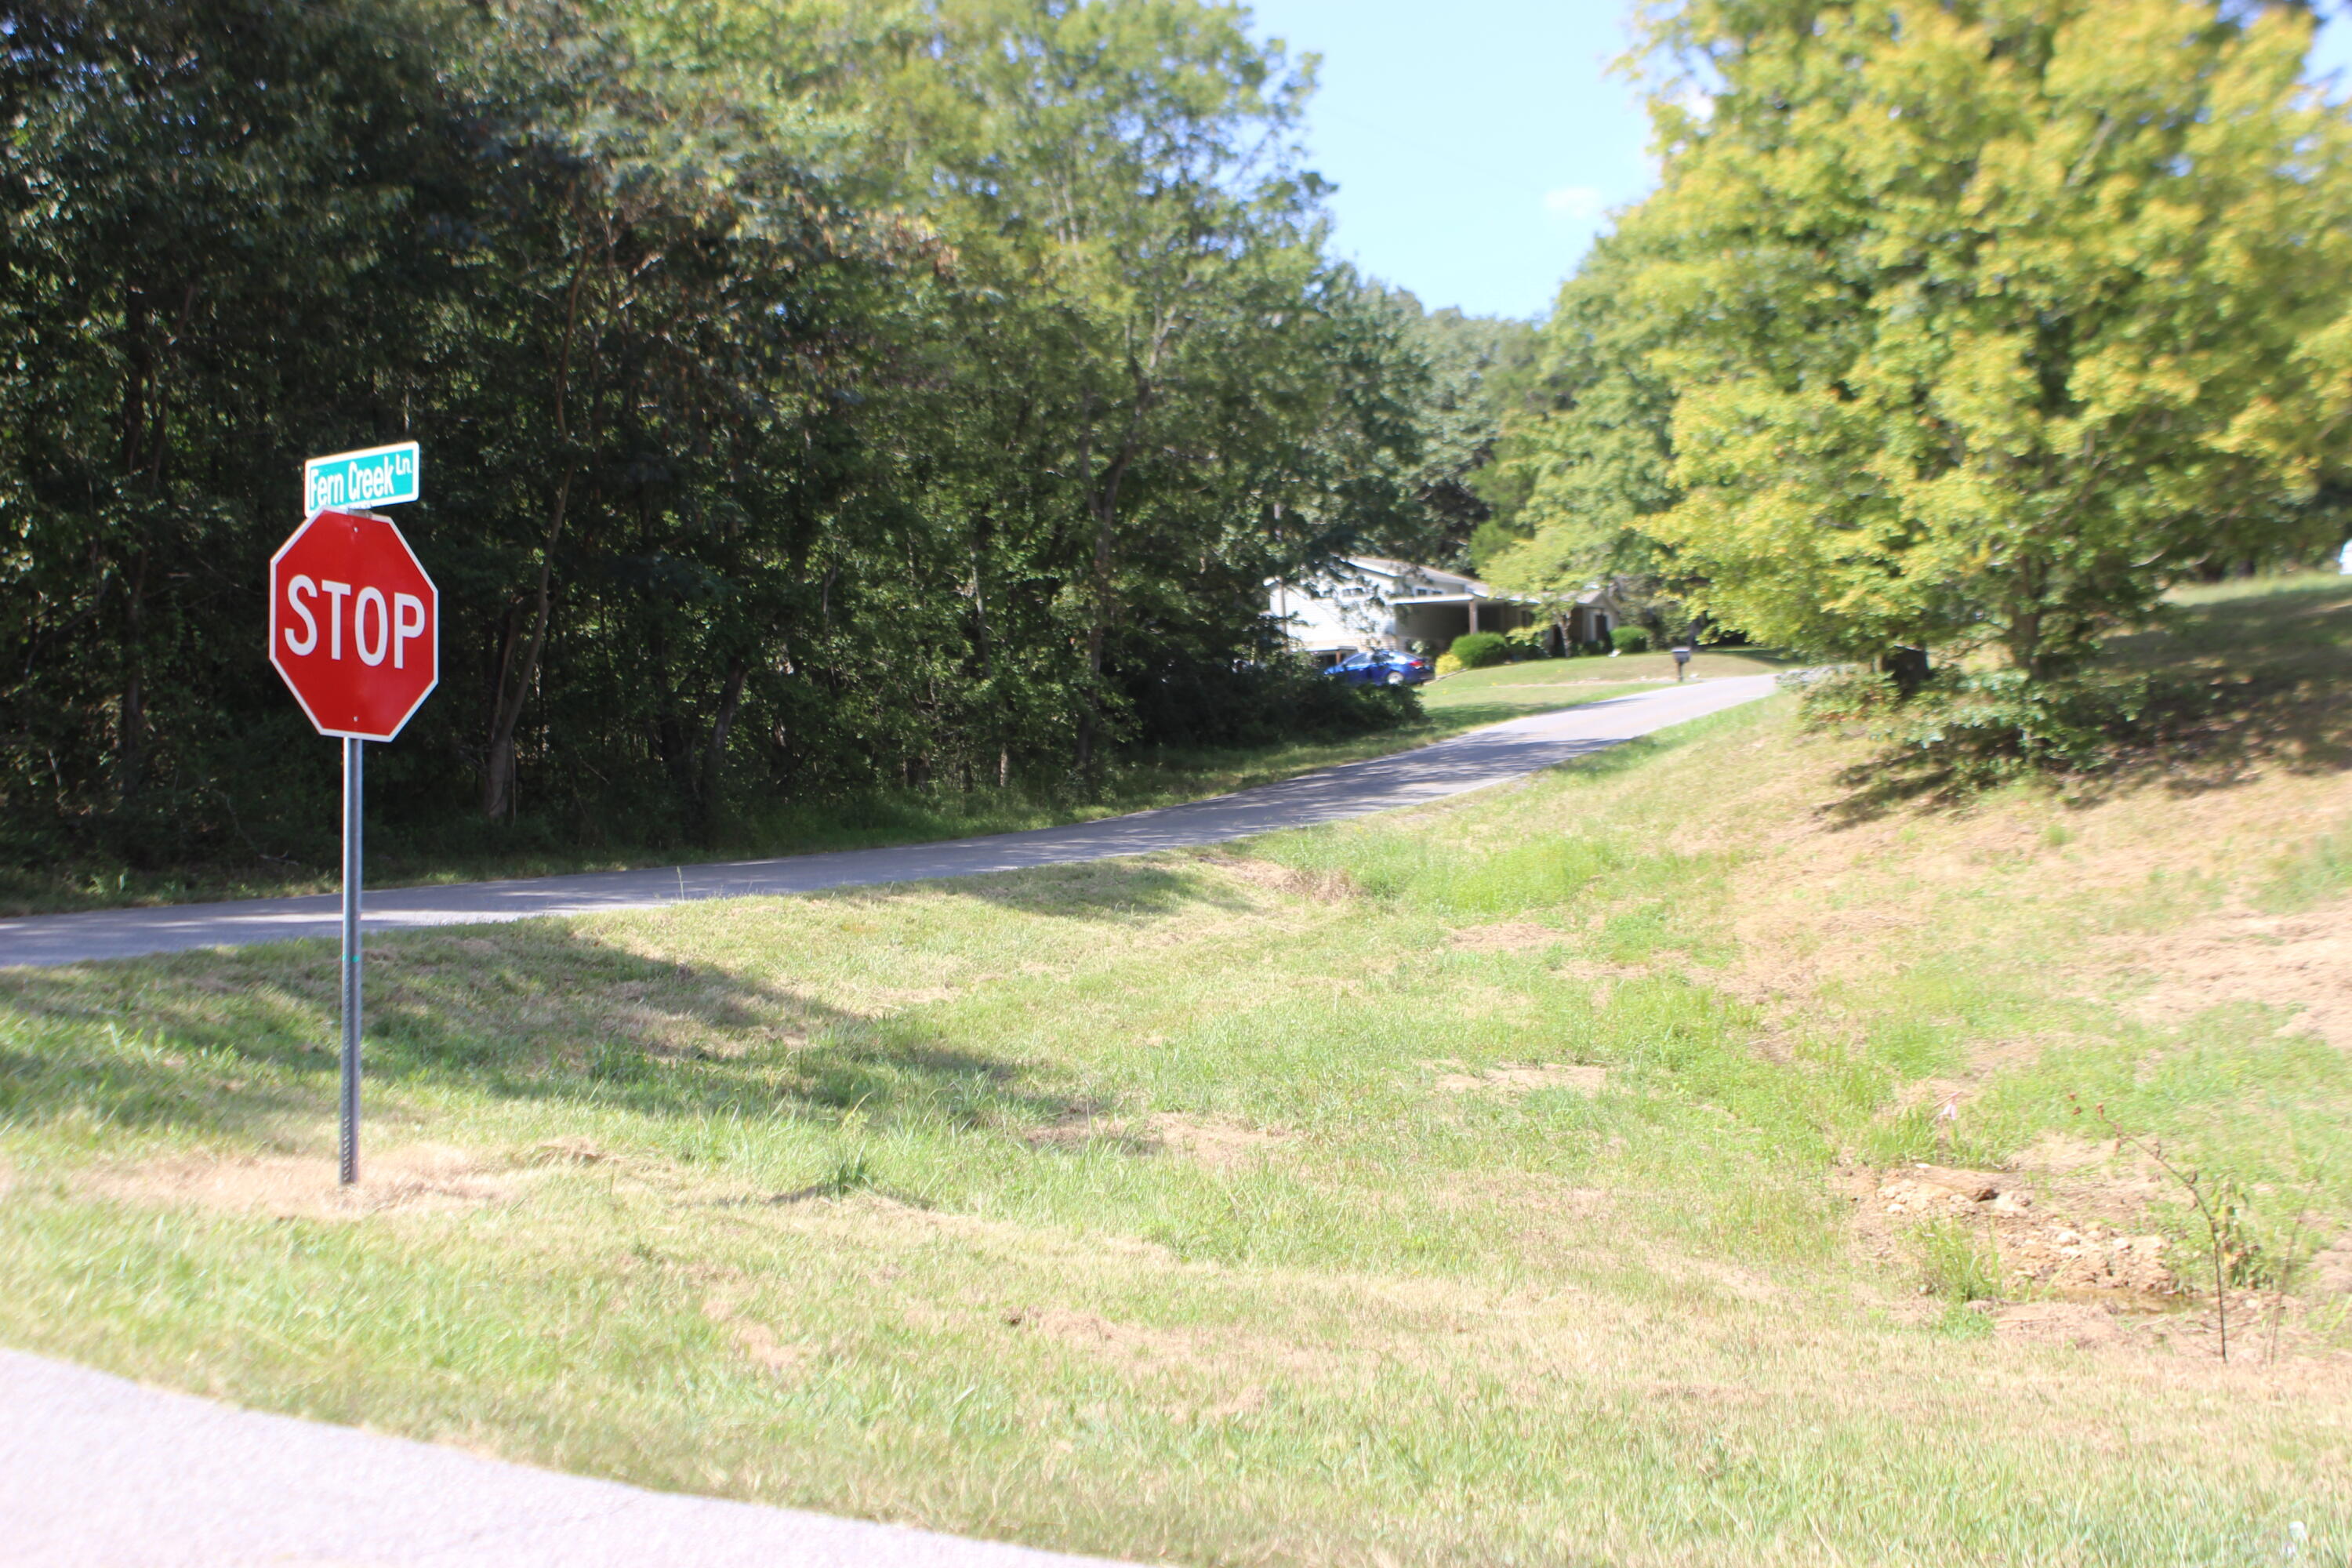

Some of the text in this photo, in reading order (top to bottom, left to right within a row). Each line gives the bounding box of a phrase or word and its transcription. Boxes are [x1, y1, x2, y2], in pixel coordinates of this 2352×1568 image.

[310, 468, 344, 508] Fern
[347, 456, 394, 502] Creek
[284, 574, 426, 670] STOP
